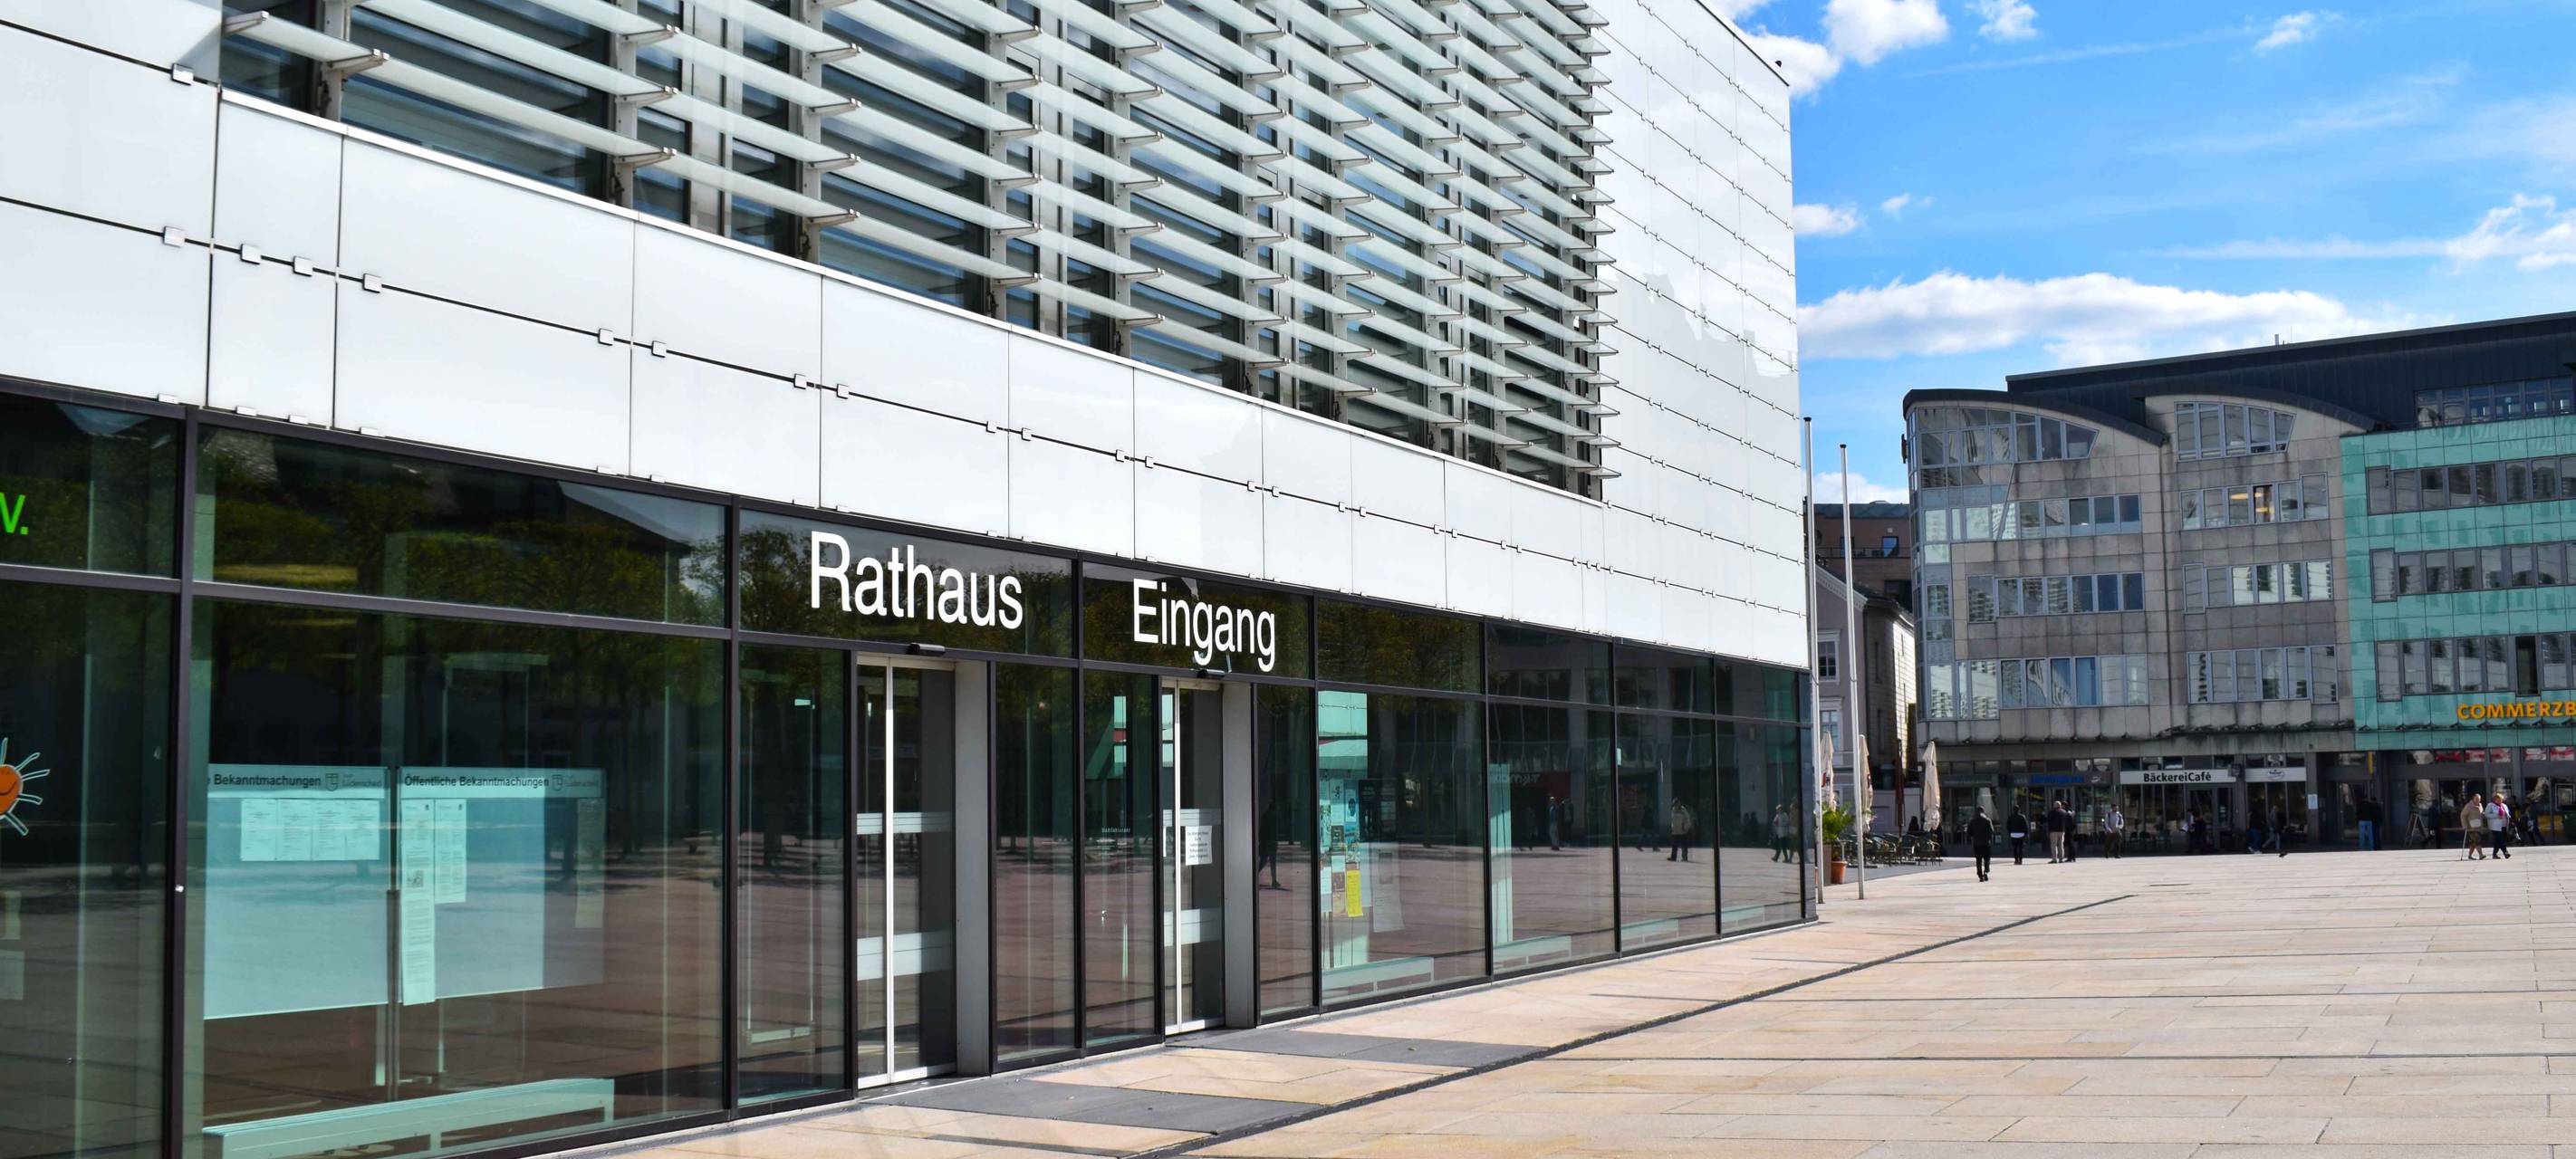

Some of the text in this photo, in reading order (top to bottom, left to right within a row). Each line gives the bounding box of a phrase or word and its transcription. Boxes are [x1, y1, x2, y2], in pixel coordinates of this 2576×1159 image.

[0, 493, 29, 535] V.
[811, 531, 1023, 629] Rathaus
[1133, 578, 1275, 673] Eingang
[2456, 701, 2576, 720] COMMERZB
[214, 773, 321, 789] Bekanntmachungen
[404, 773, 457, 787] Öffentliche
[459, 775, 549, 789] Bekanntmachungen
[2143, 771, 2212, 782] BäckereiCafé
